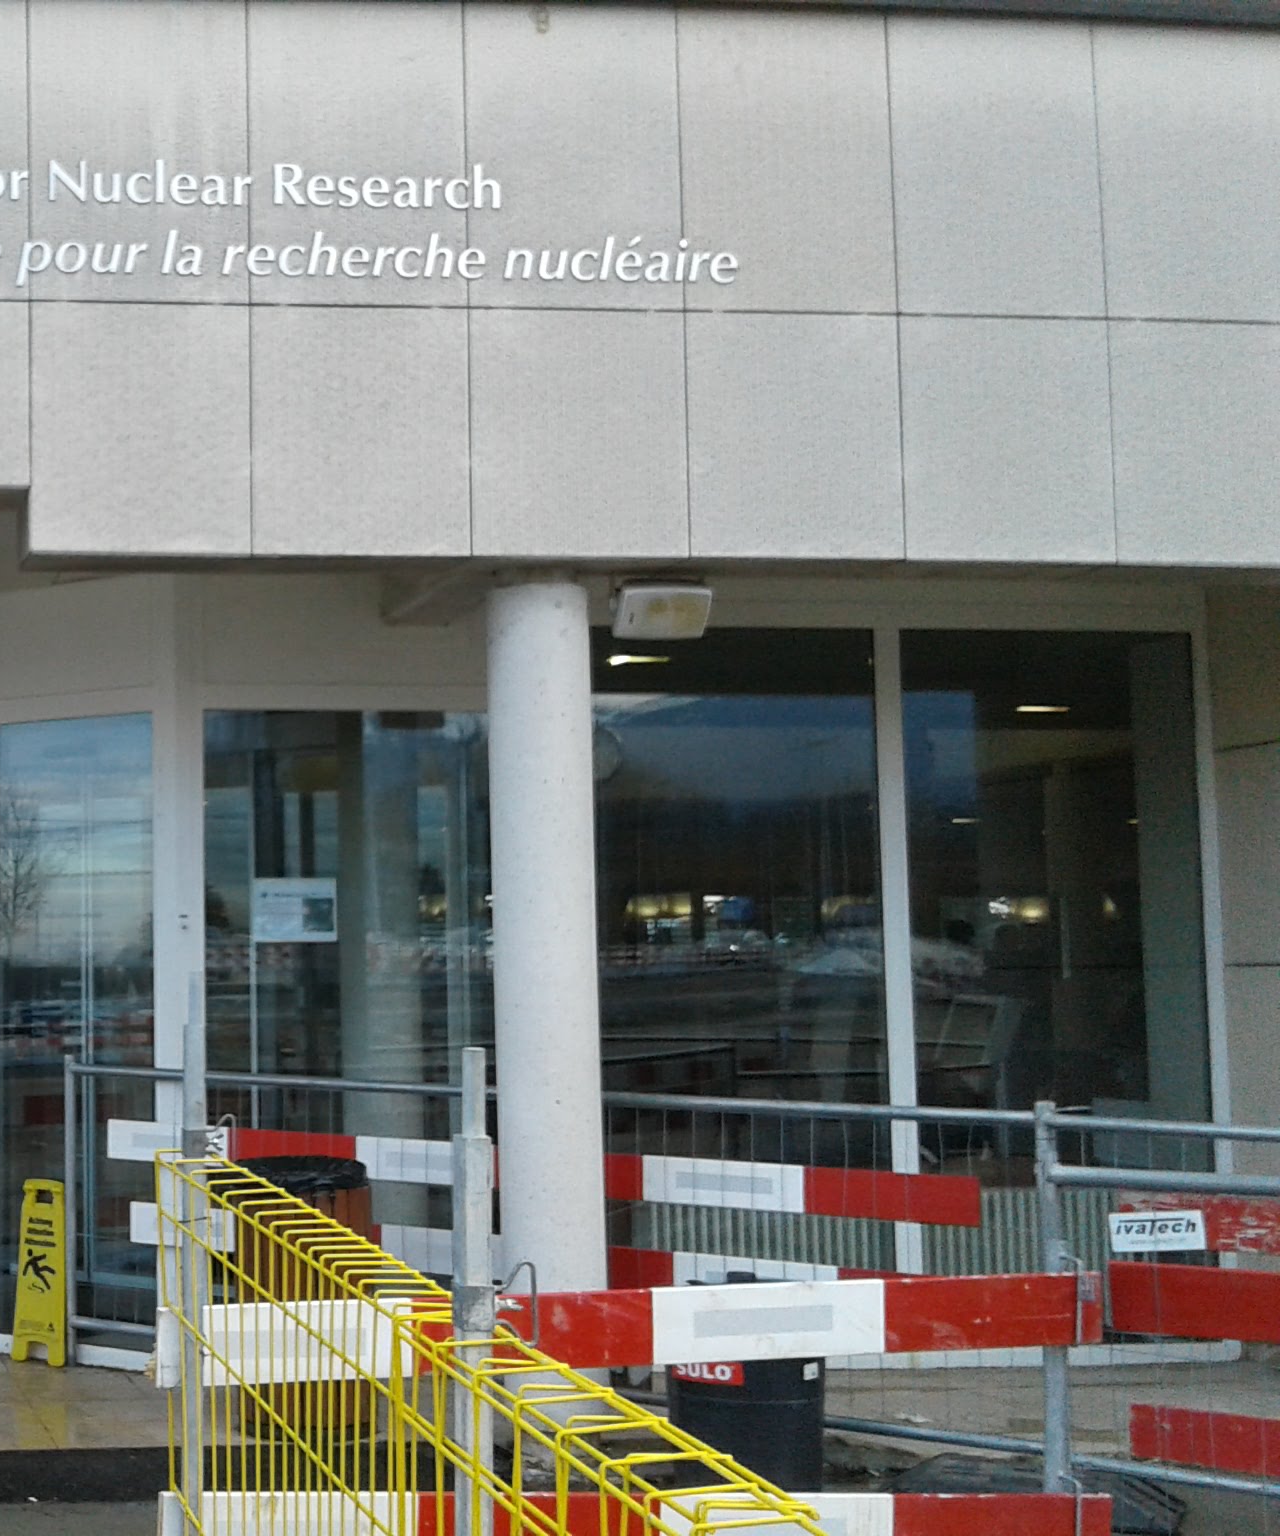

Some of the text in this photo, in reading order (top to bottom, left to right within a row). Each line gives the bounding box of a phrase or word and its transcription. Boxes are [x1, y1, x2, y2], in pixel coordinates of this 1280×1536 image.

[48, 158, 252, 207] Nuclear
[273, 162, 503, 211] Research
[17, 238, 147, 288] pour
[161, 230, 203, 277] la
[221, 231, 487, 281] recherche
[502, 236, 739, 286] nucléaire
[676, 1363, 732, 1381] SULO
